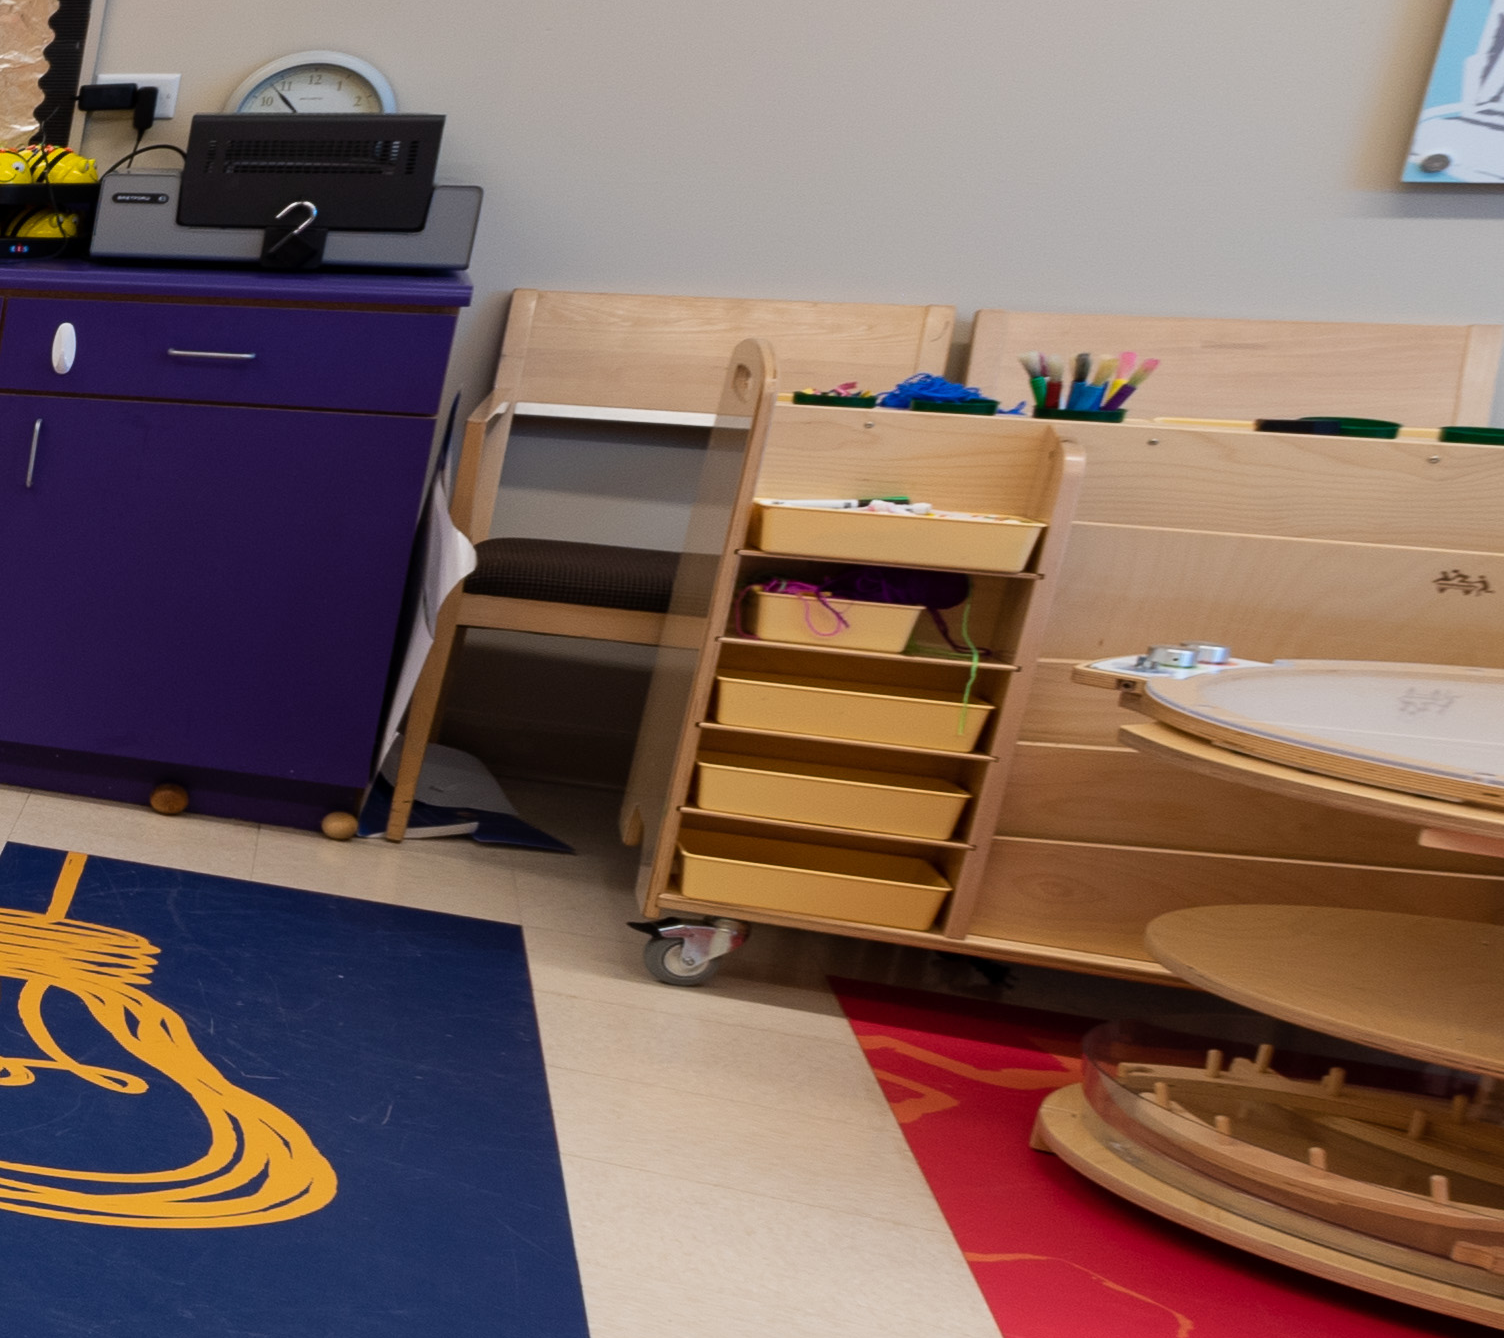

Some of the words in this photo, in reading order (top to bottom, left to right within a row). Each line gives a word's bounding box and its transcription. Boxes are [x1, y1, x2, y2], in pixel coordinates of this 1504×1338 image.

[308, 74, 323, 85] 12
[280, 80, 293, 92] 11
[260, 95, 274, 107] 10
[353, 95, 362, 107] 2
